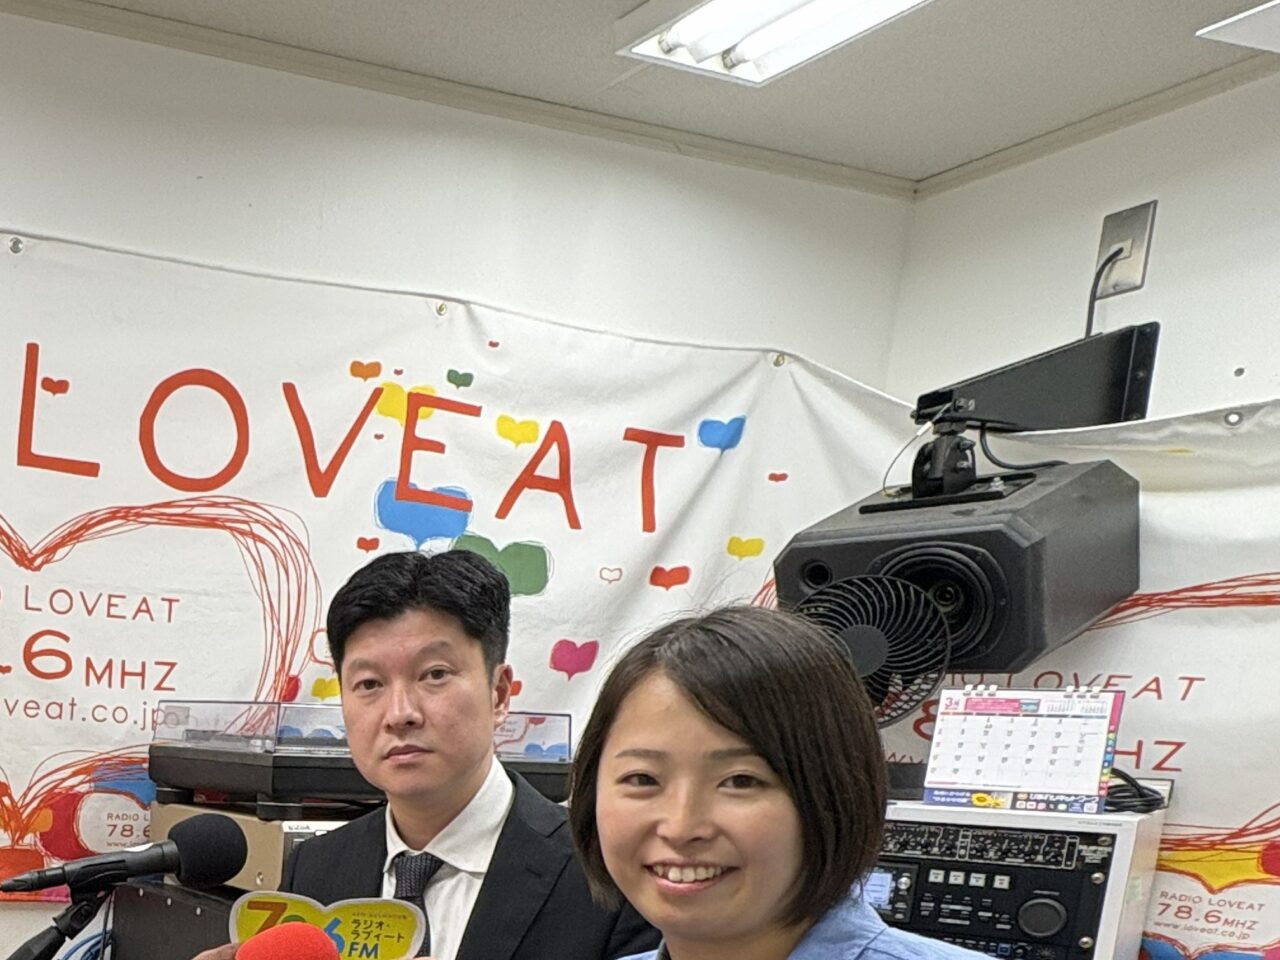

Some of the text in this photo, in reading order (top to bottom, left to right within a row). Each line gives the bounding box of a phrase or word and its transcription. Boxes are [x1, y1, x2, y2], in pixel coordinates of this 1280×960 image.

[17, 342, 685, 533] LOVEAT
[24, 586, 180, 623] LOVEAT
[85, 656, 177, 692] MHZ
[107, 813, 139, 821] RADIO
[1160, 891, 1265, 911] RADIO LOVEAT
[1158, 903, 1259, 930] 78.6 MHZ
[348, 942, 379, 959] FM
